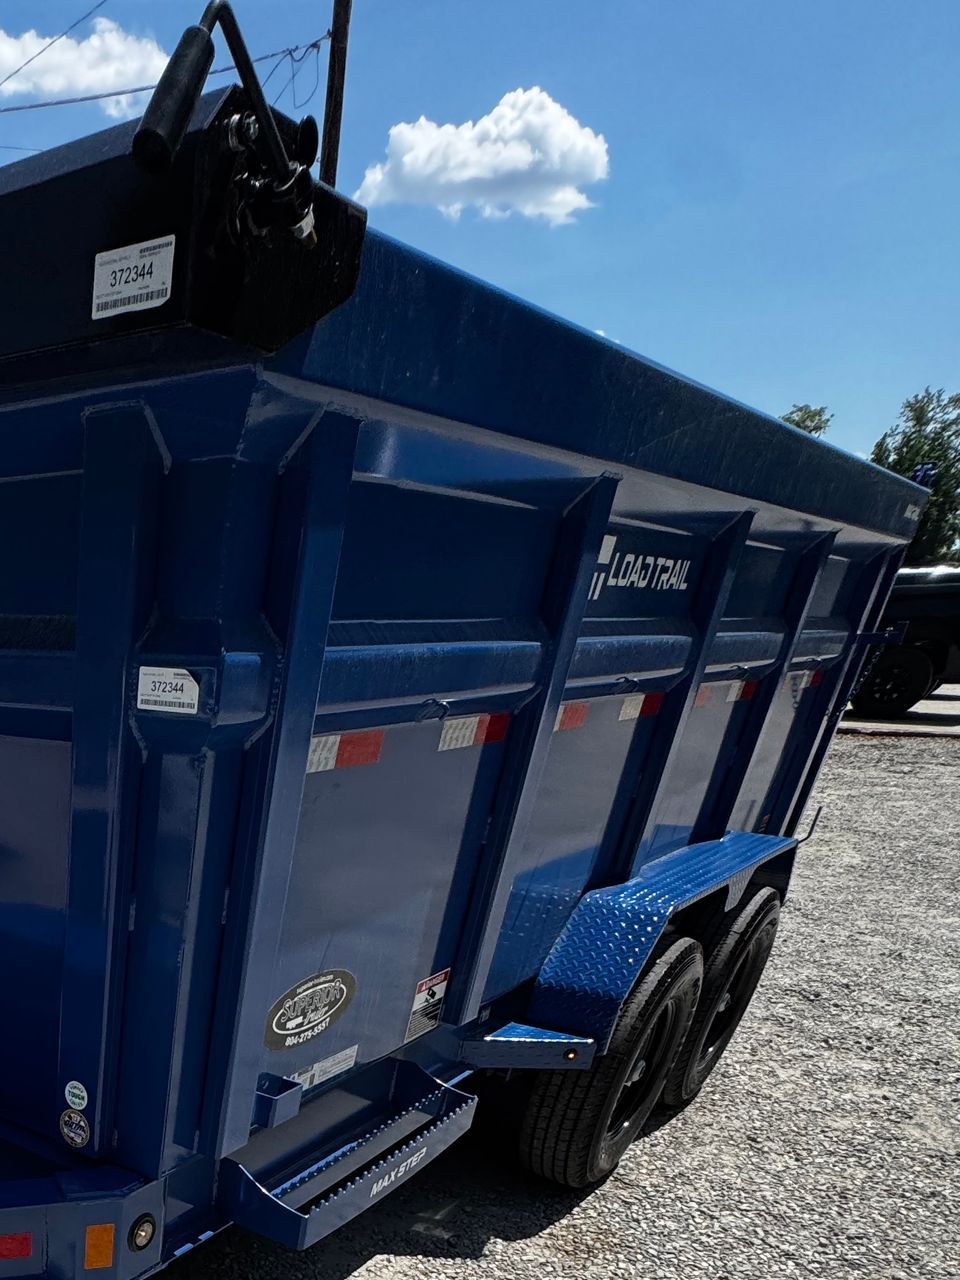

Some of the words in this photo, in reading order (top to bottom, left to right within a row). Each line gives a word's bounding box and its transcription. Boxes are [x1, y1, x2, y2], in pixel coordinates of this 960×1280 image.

[110, 260, 154, 288] 372344
[607, 552, 655, 588] LOAD
[651, 557, 691, 590] TRAIL
[151, 680, 184, 694] 372344
[281, 978, 342, 1023] SUPERIOR
[370, 1168, 398, 1198] MAX
[397, 1147, 427, 1177] STEP
